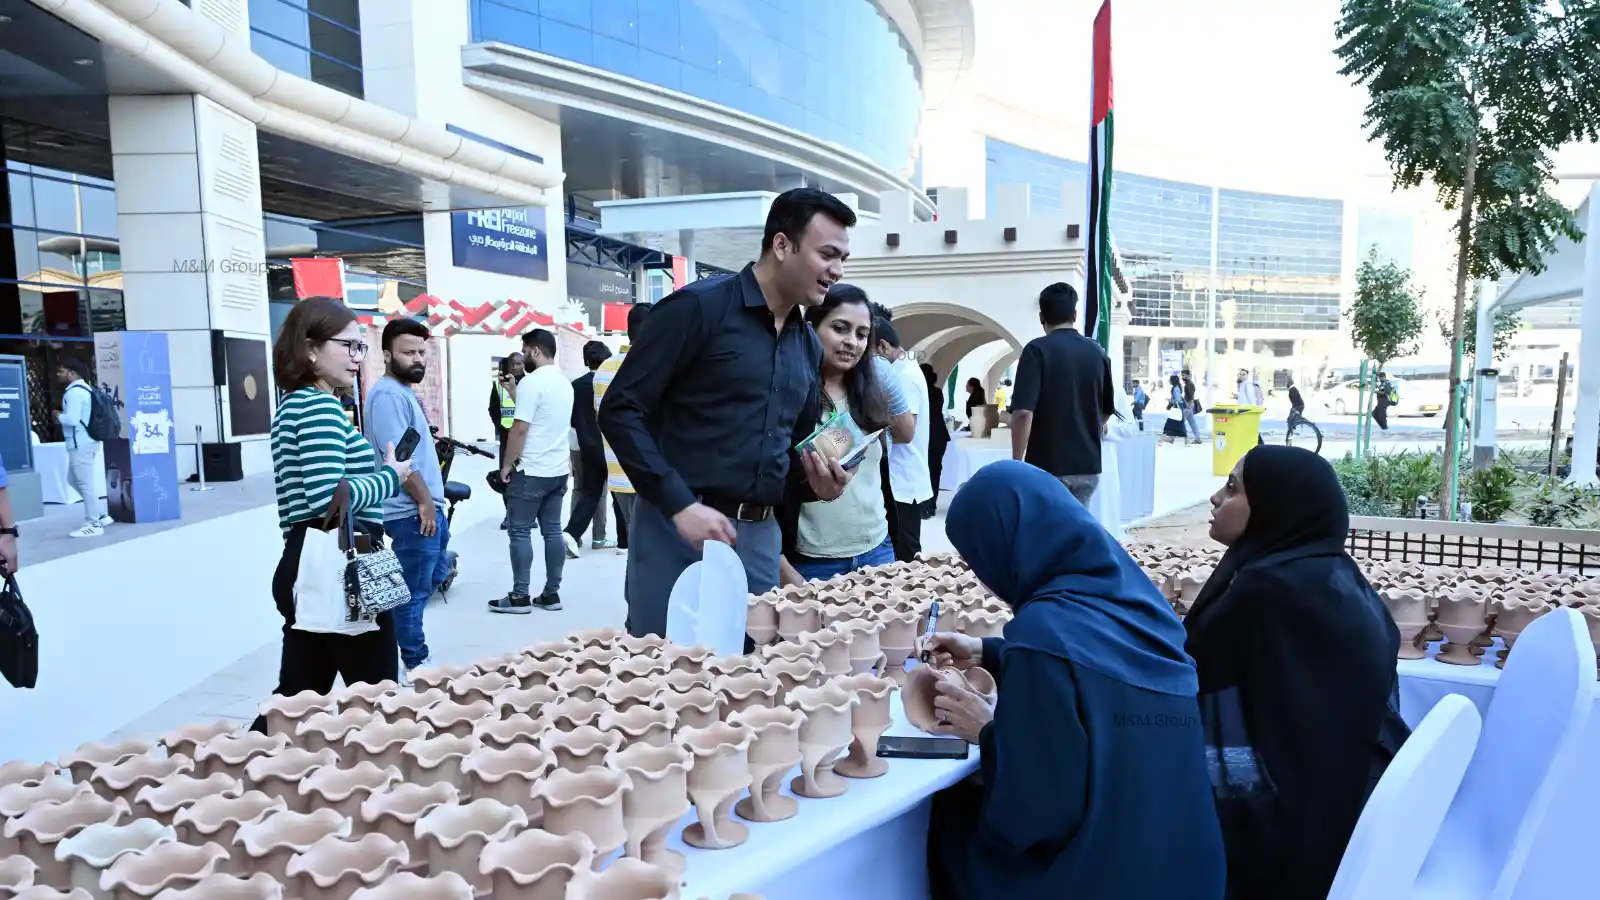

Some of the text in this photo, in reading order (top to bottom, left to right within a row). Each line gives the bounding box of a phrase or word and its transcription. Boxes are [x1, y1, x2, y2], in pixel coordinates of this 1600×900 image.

[502, 208, 527, 224] Airport
[502, 216, 537, 239] Freezone
[143, 421, 164, 438] 54
